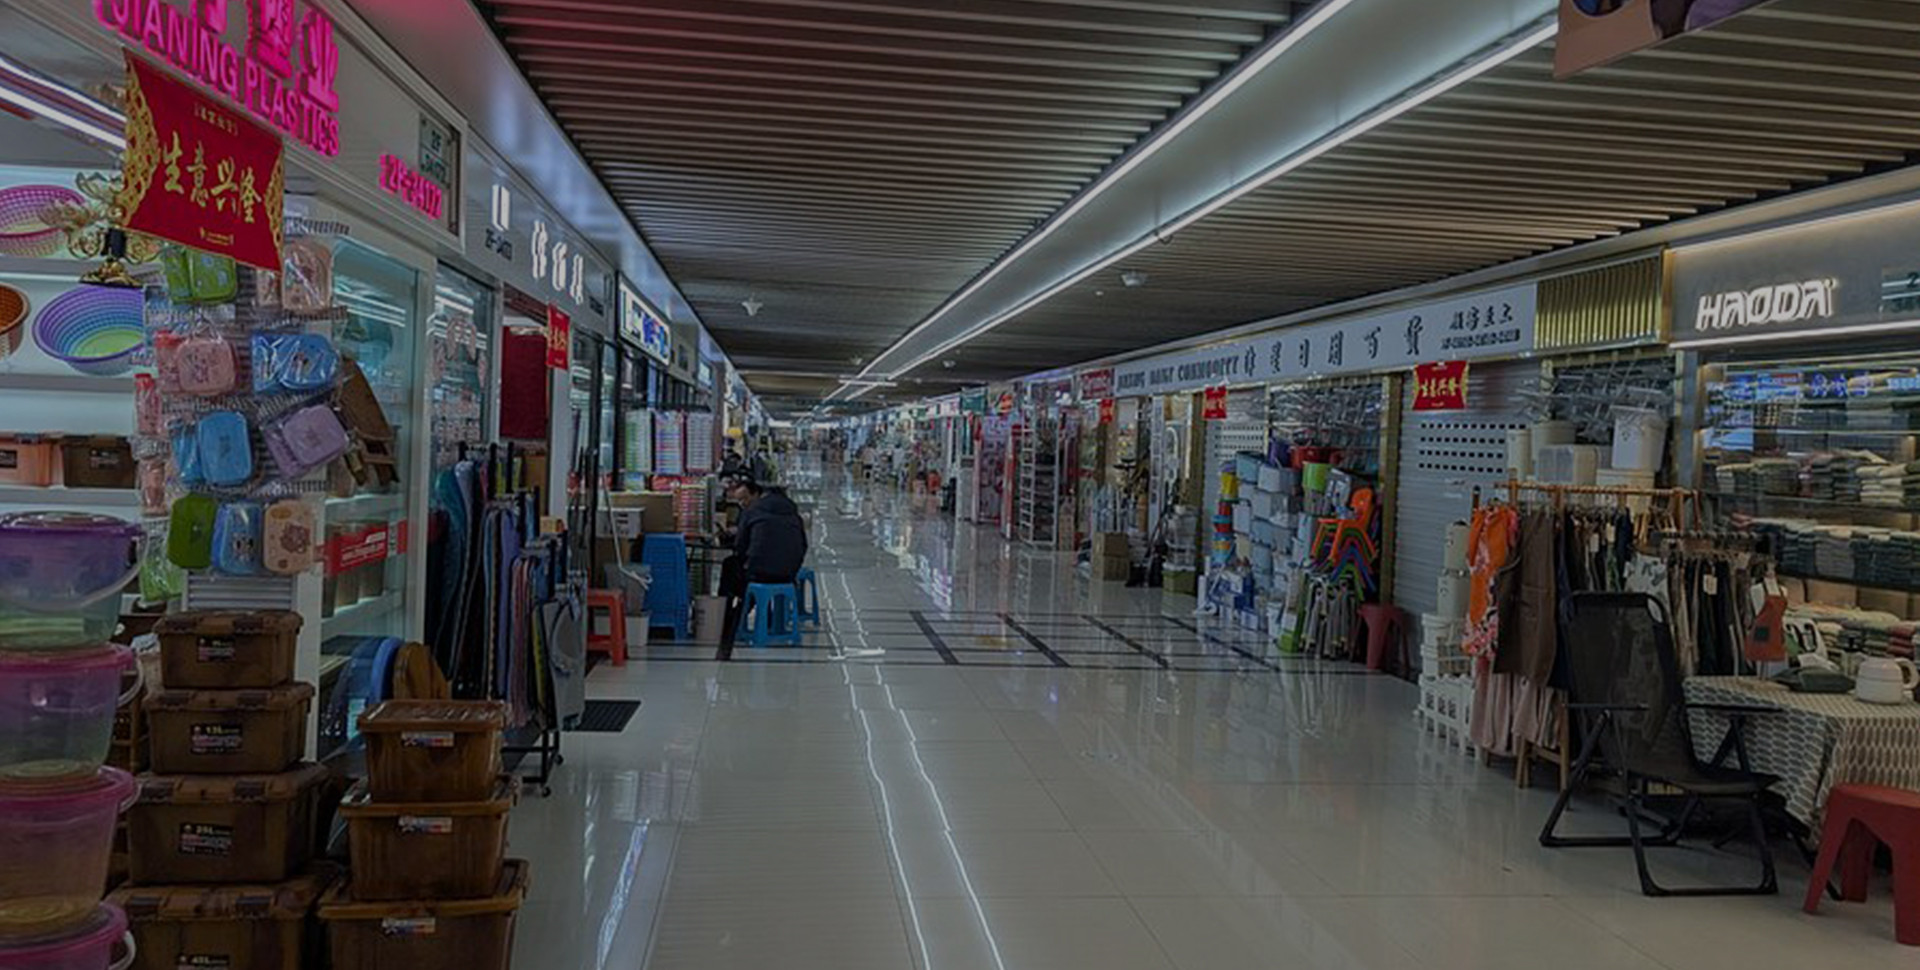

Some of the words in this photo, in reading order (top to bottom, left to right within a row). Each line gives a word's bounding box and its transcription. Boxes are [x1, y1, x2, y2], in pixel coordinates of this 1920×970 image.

[246, 58, 339, 157] PLASTICS
[162, 131, 263, 223] 生意兴隆
